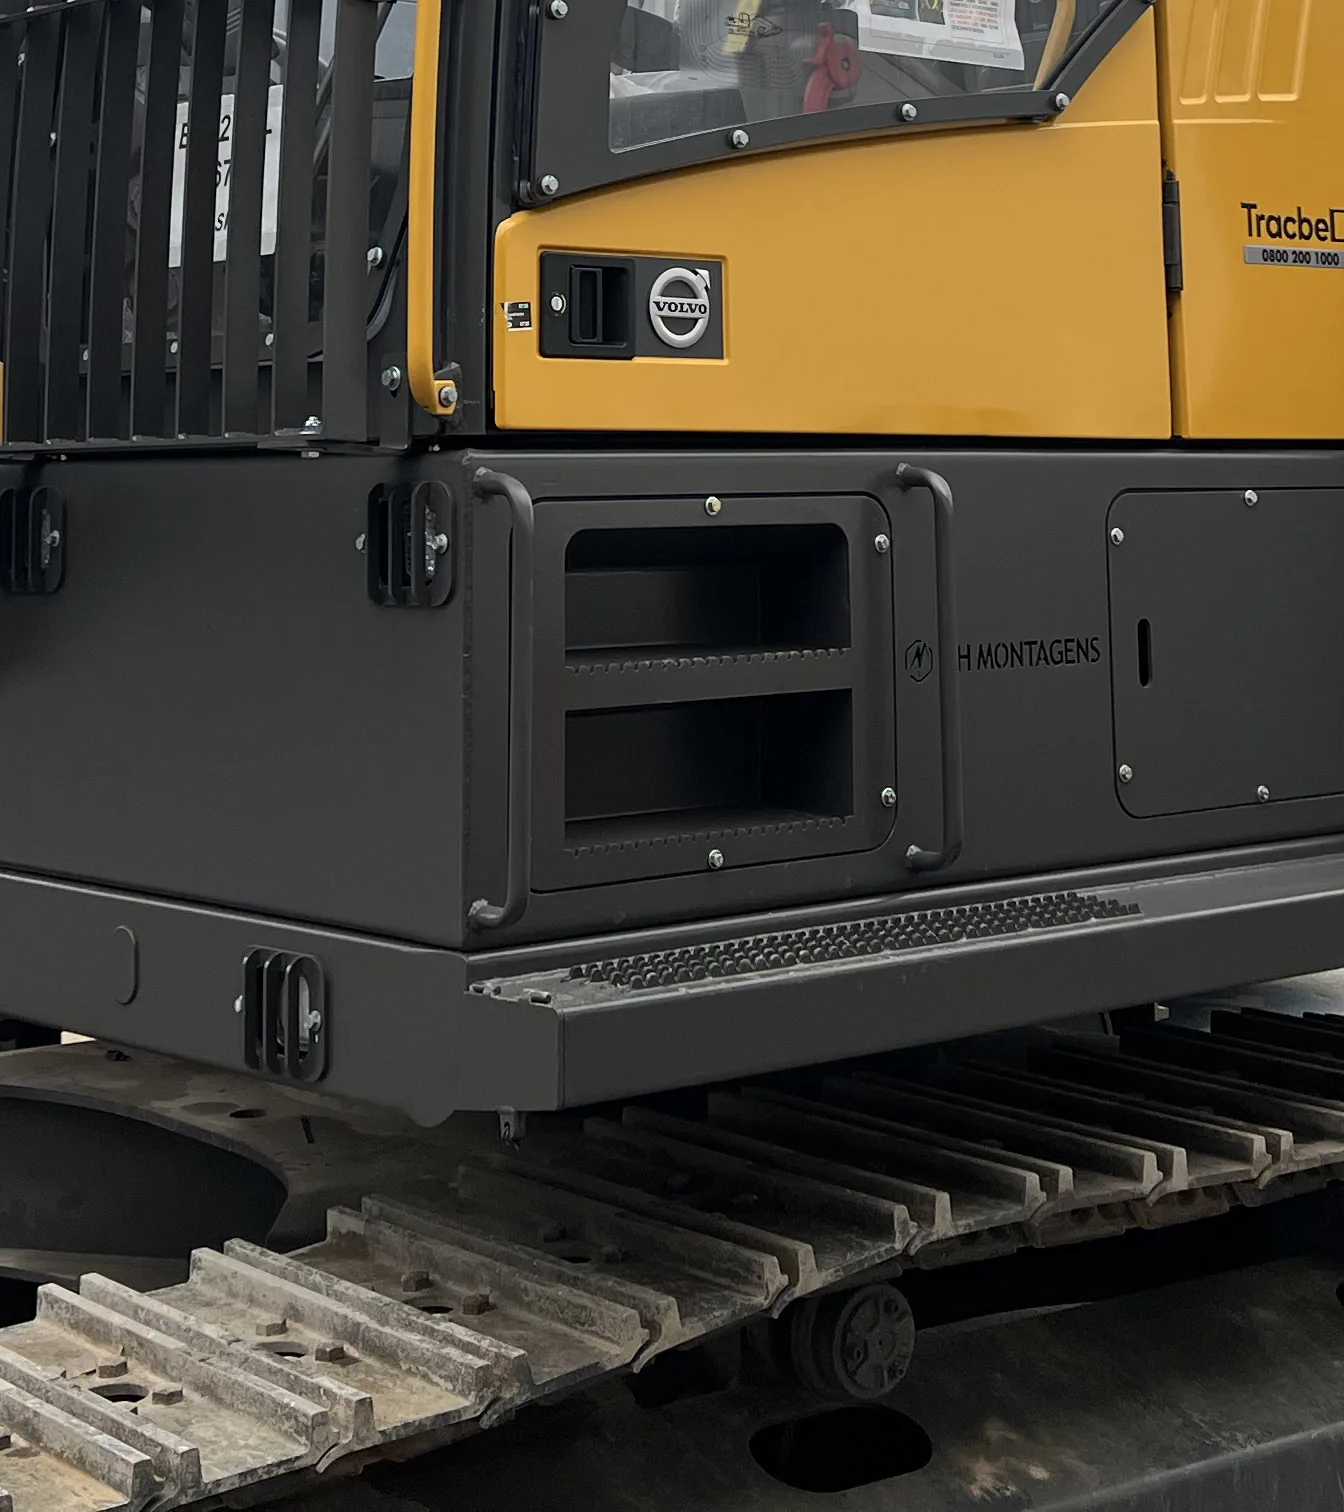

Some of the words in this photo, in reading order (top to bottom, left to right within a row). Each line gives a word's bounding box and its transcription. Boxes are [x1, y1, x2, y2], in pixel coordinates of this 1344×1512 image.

[1261, 248, 1289, 263] 0800
[1291, 250, 1312, 265] 200
[1315, 251, 1340, 266] 1000
[652, 300, 708, 315] VOLVO
[976, 636, 1101, 671] MONTAGENS
